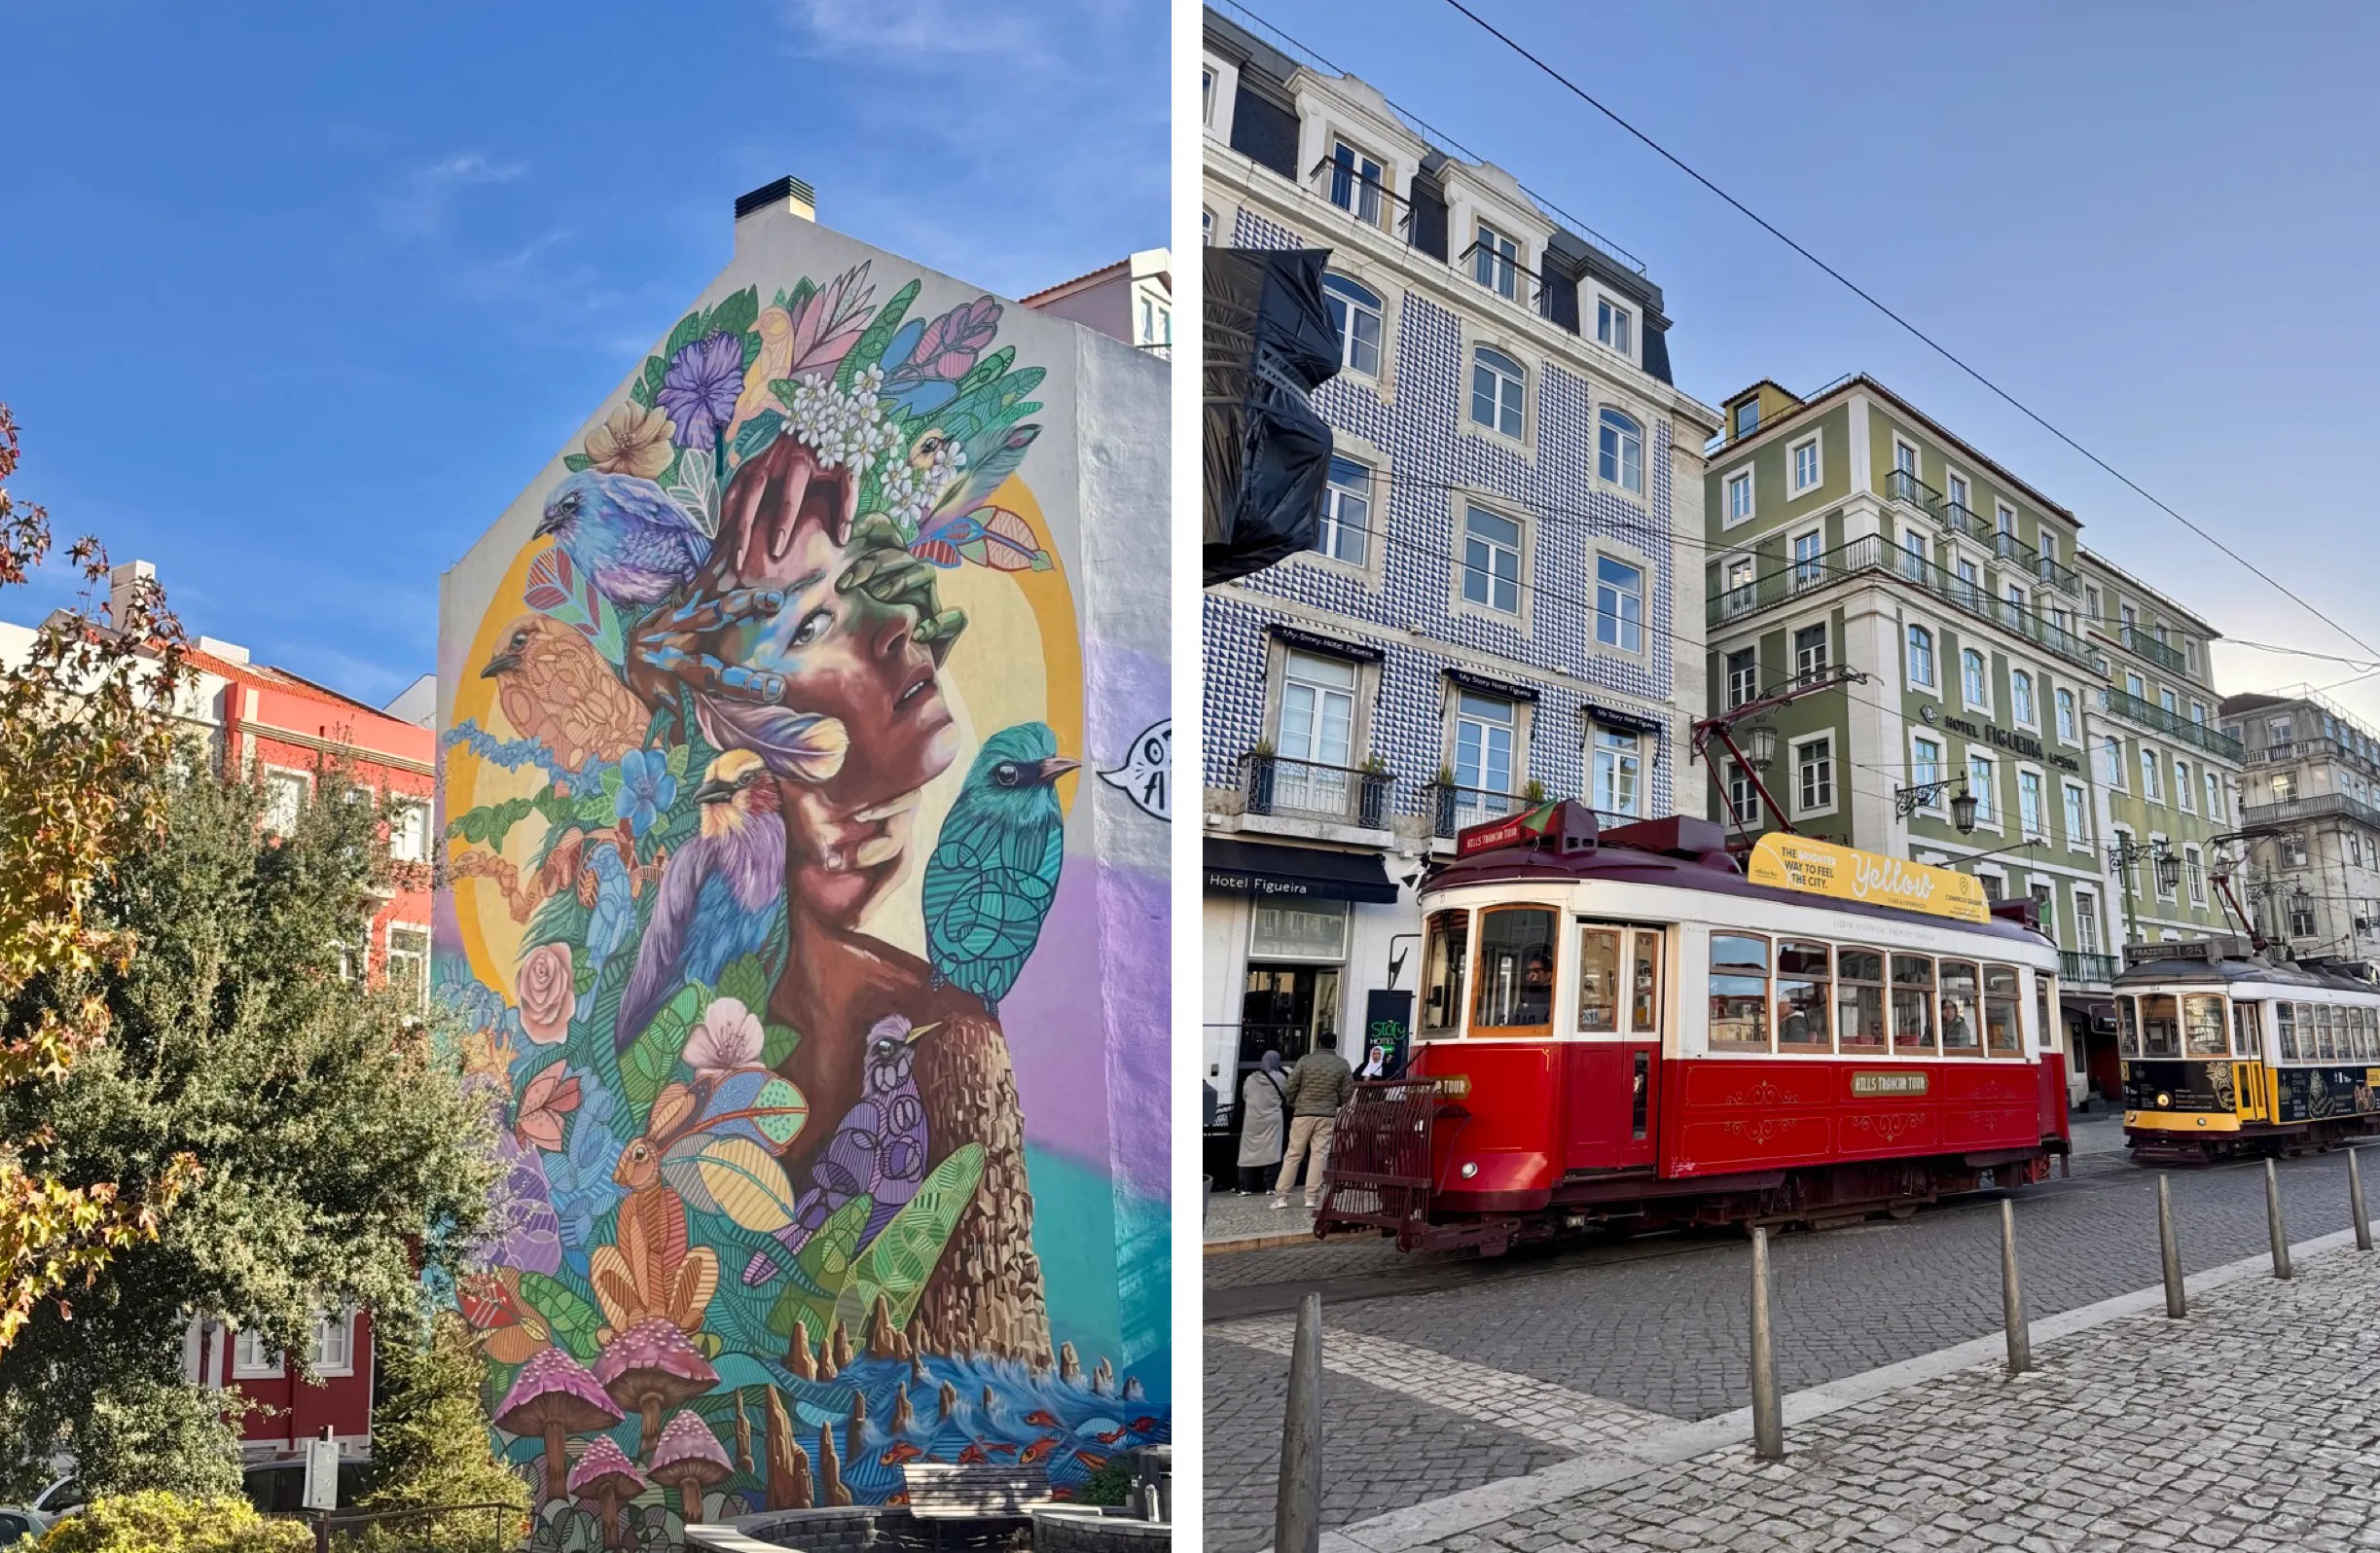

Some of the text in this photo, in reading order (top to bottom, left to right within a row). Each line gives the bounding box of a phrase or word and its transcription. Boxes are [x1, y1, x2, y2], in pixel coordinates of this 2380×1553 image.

[1282, 630, 1374, 658] My Story Hotel Figueira
[1460, 672, 1532, 698] My Story Hotel Figueira
[1945, 715, 2079, 772] HOTEL FIGUEIRA LISBOA
[1466, 836, 1482, 849] HILLS
[1503, 826, 1517, 838] TOUR
[1781, 847, 1837, 866] THE BRIGHTER
[1785, 859, 1834, 879] WAY TO FEEL
[1851, 853, 1935, 899] Yellow
[1209, 874, 1307, 893] Hotel Figueira
[1791, 873, 1807, 885] THE
[1808, 877, 1828, 889] CITY.
[2132, 946, 2175, 957] PRAZERES
[2186, 945, 2203, 956] 25
[1369, 1036, 1396, 1045] HOTEL
[1444, 1080, 1465, 1094] TOUR
[1856, 1076, 1926, 1091] HILLS TRAMCAR TOUR
